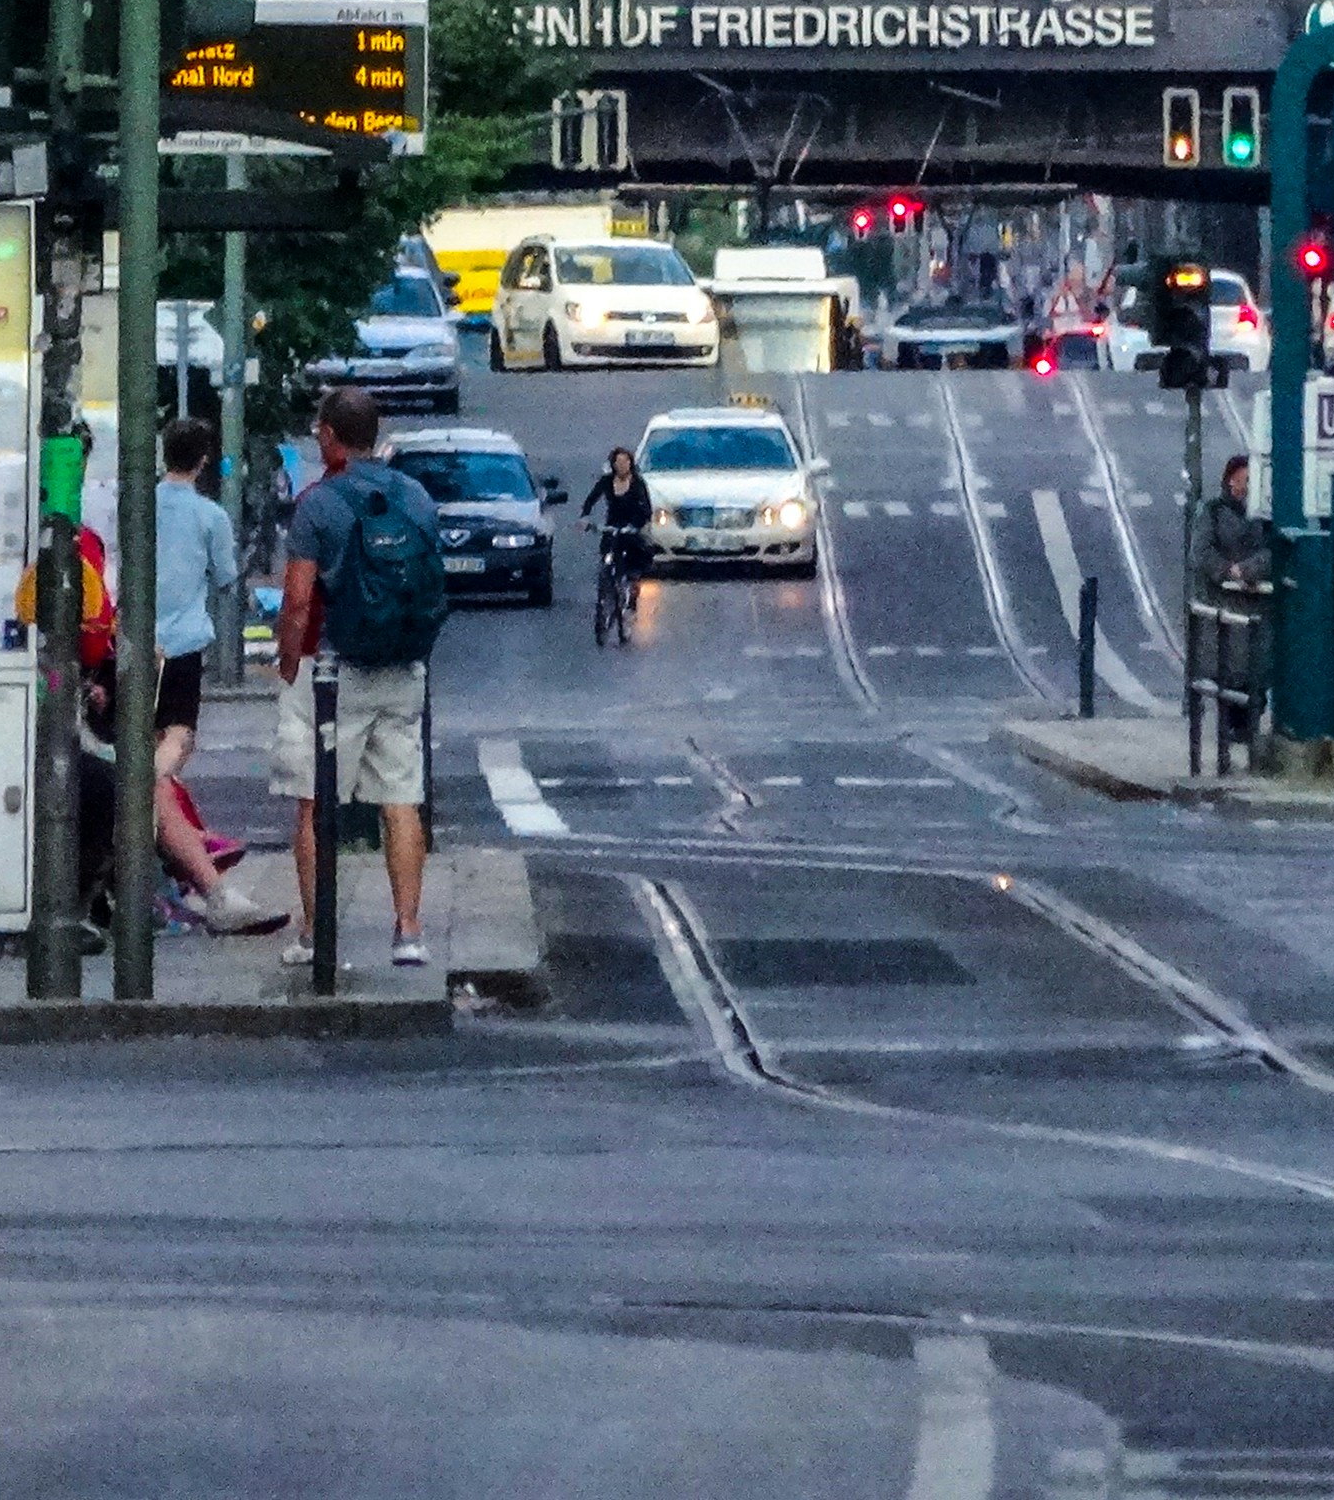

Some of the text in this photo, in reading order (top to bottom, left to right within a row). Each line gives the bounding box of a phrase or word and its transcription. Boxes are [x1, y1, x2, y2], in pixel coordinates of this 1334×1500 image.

[690, 4, 1155, 49] FRIEDRICHSTRASSE
[356, 30, 365, 51] 1
[370, 29, 405, 52] min
[213, 65, 255, 88] Nord
[354, 65, 367, 88] 4
[370, 66, 405, 89] min
